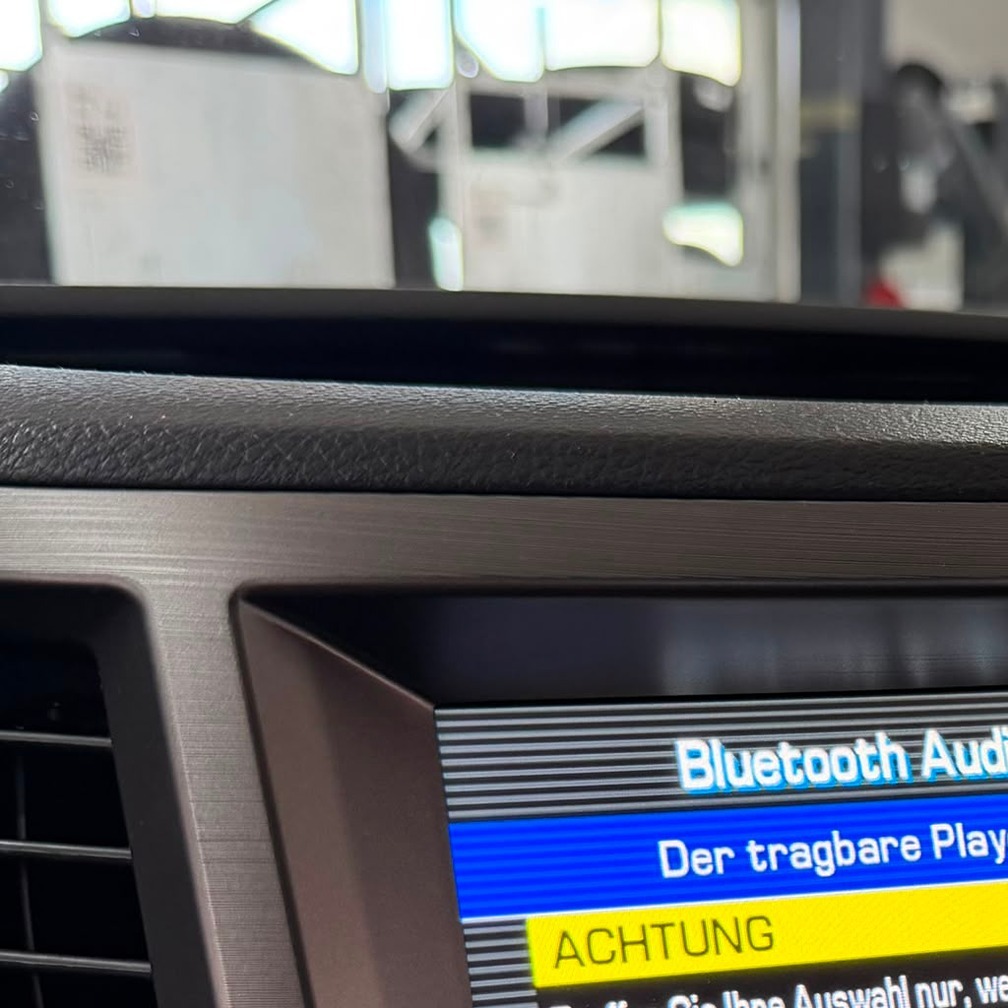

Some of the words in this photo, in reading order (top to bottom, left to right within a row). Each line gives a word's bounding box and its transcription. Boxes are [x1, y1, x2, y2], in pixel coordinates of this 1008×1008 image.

[675, 731, 910, 791] Bluetooth
[658, 838, 735, 879] Der
[746, 829, 921, 876] tragbare
[554, 914, 775, 969] ACHTUNG
